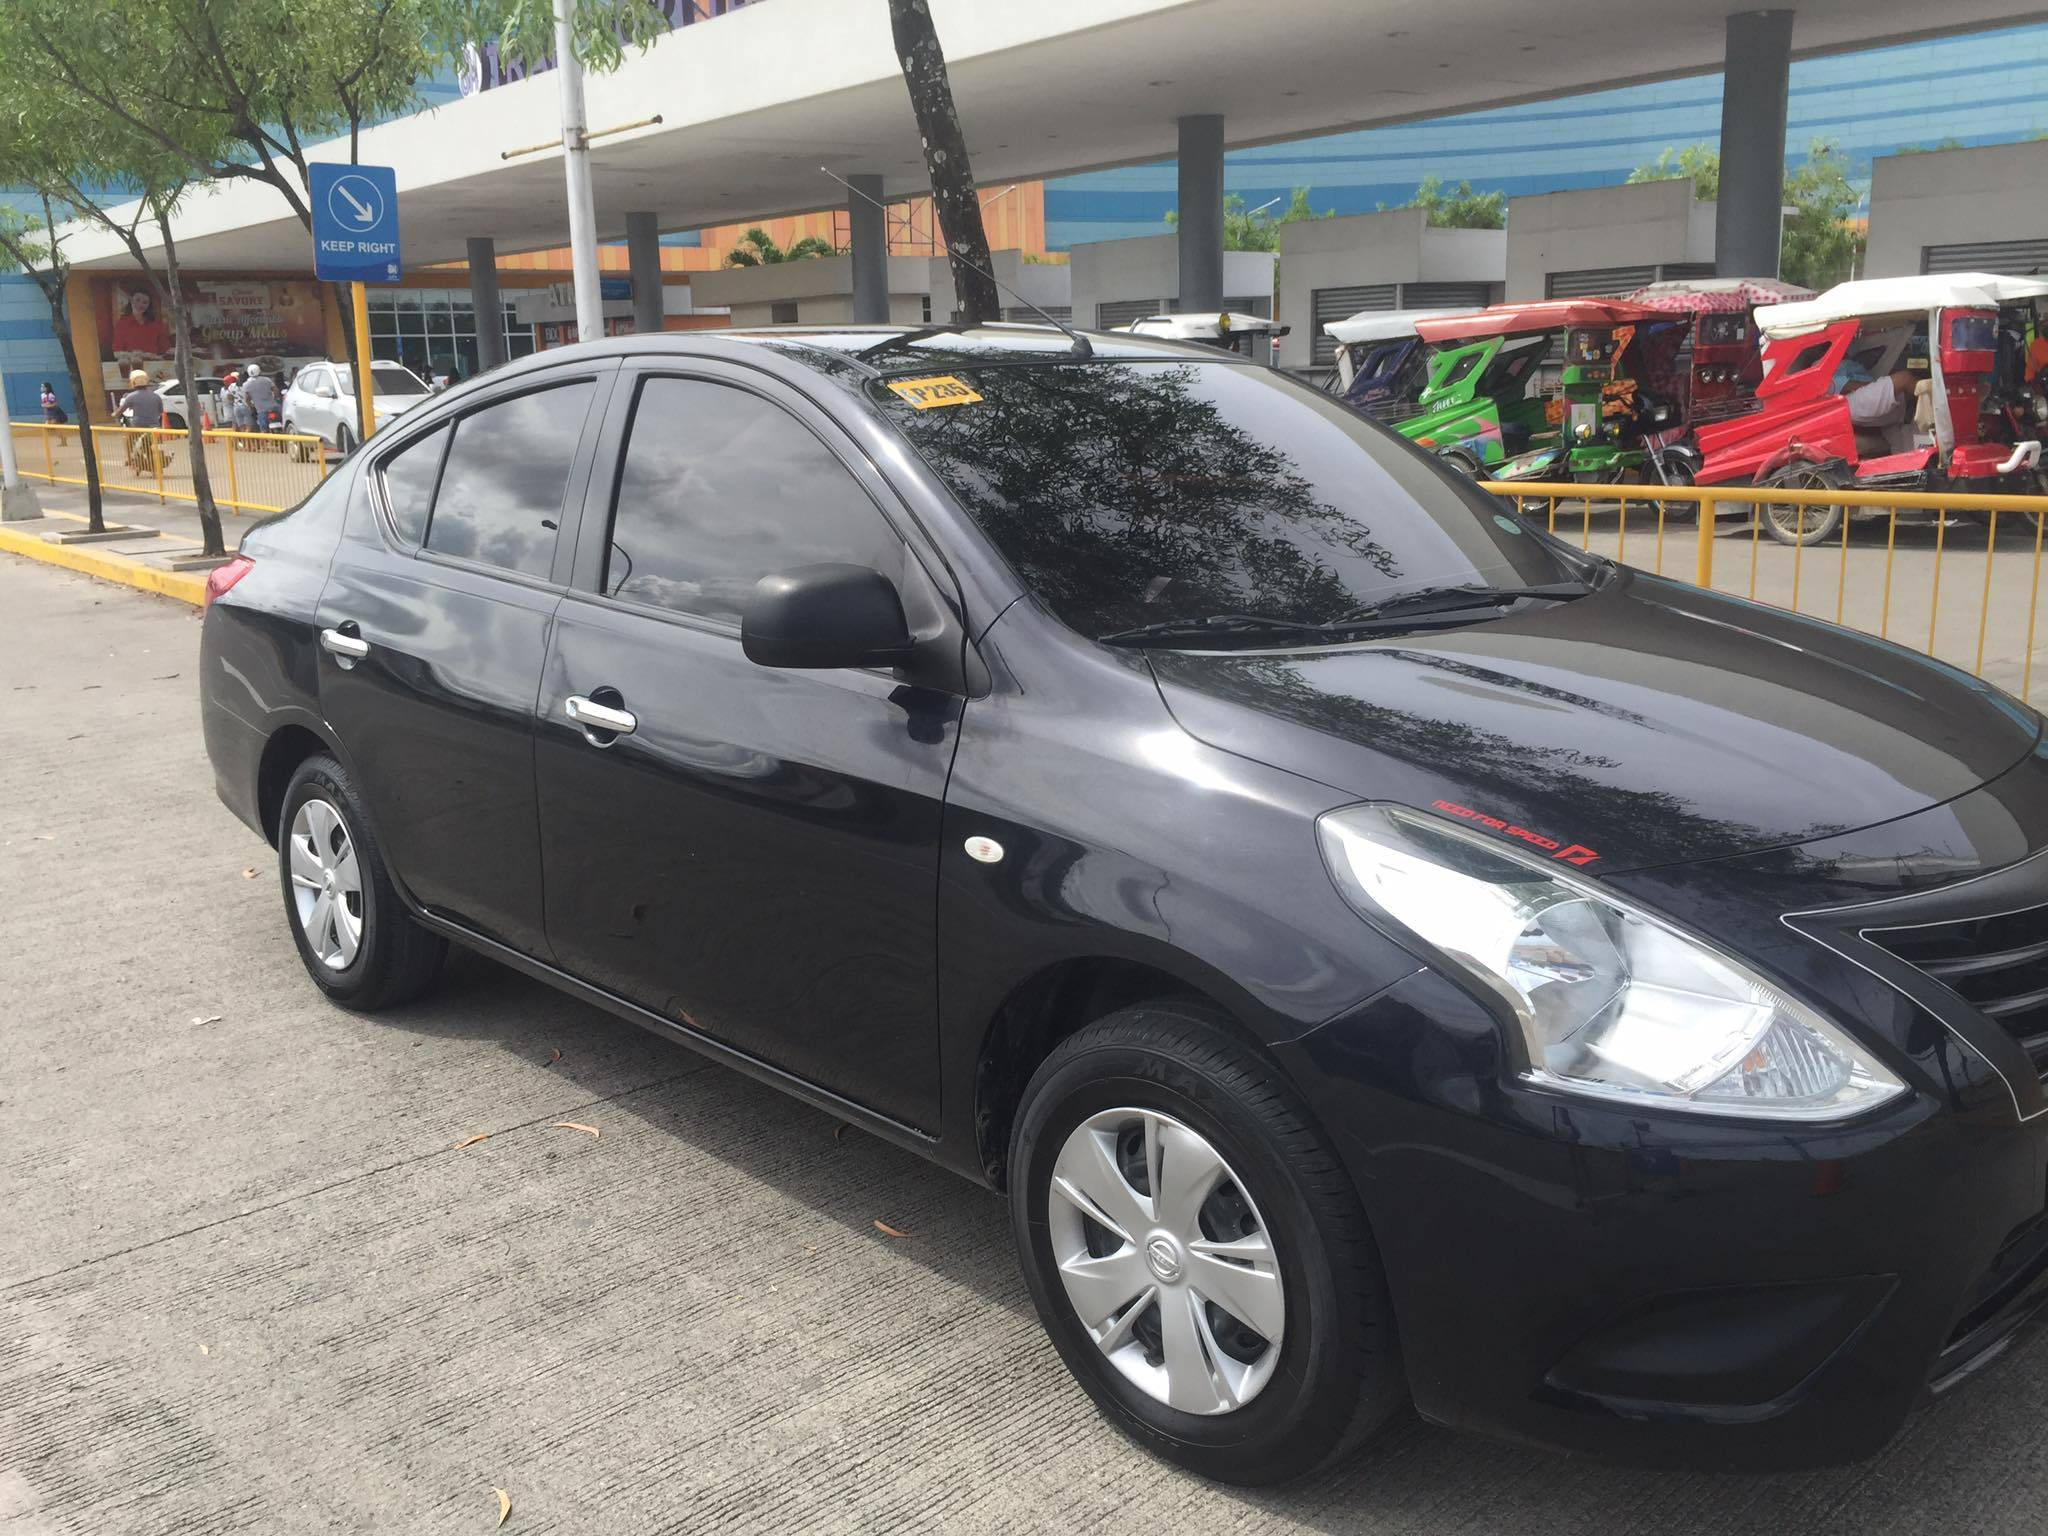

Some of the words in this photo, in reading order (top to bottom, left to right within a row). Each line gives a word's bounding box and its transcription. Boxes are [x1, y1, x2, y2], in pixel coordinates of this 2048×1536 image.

[321, 240, 355, 252] KEEP
[358, 241, 396, 254] RIGHT
[202, 327, 244, 342] Group
[1432, 800, 1475, 818] NEED
[1472, 812, 1507, 830] FOR
[1504, 825, 1561, 850] SPEED
